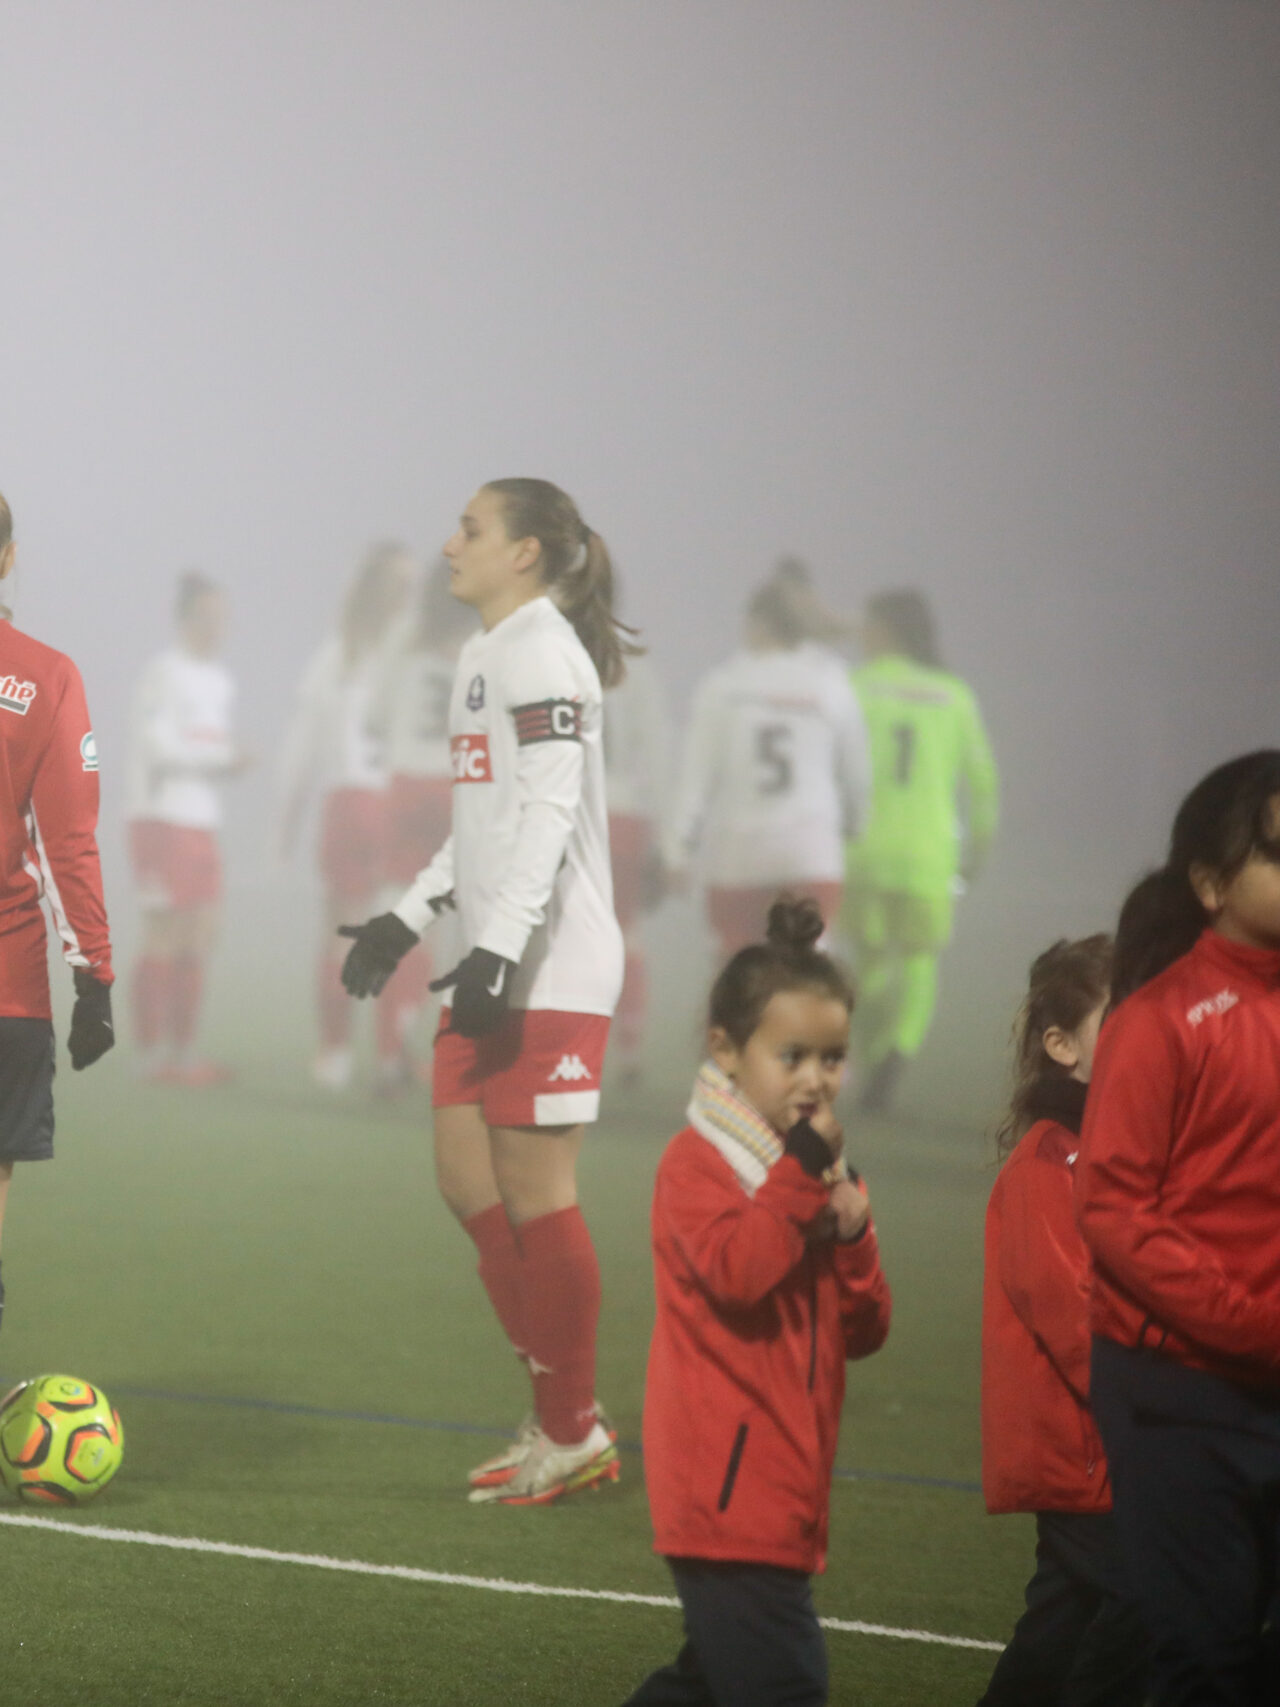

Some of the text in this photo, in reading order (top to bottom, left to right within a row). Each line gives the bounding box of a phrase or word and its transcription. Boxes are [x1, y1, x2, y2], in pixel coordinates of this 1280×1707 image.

[552, 704, 576, 735] C
[890, 719, 916, 789] 1
[752, 722, 793, 796] 5
